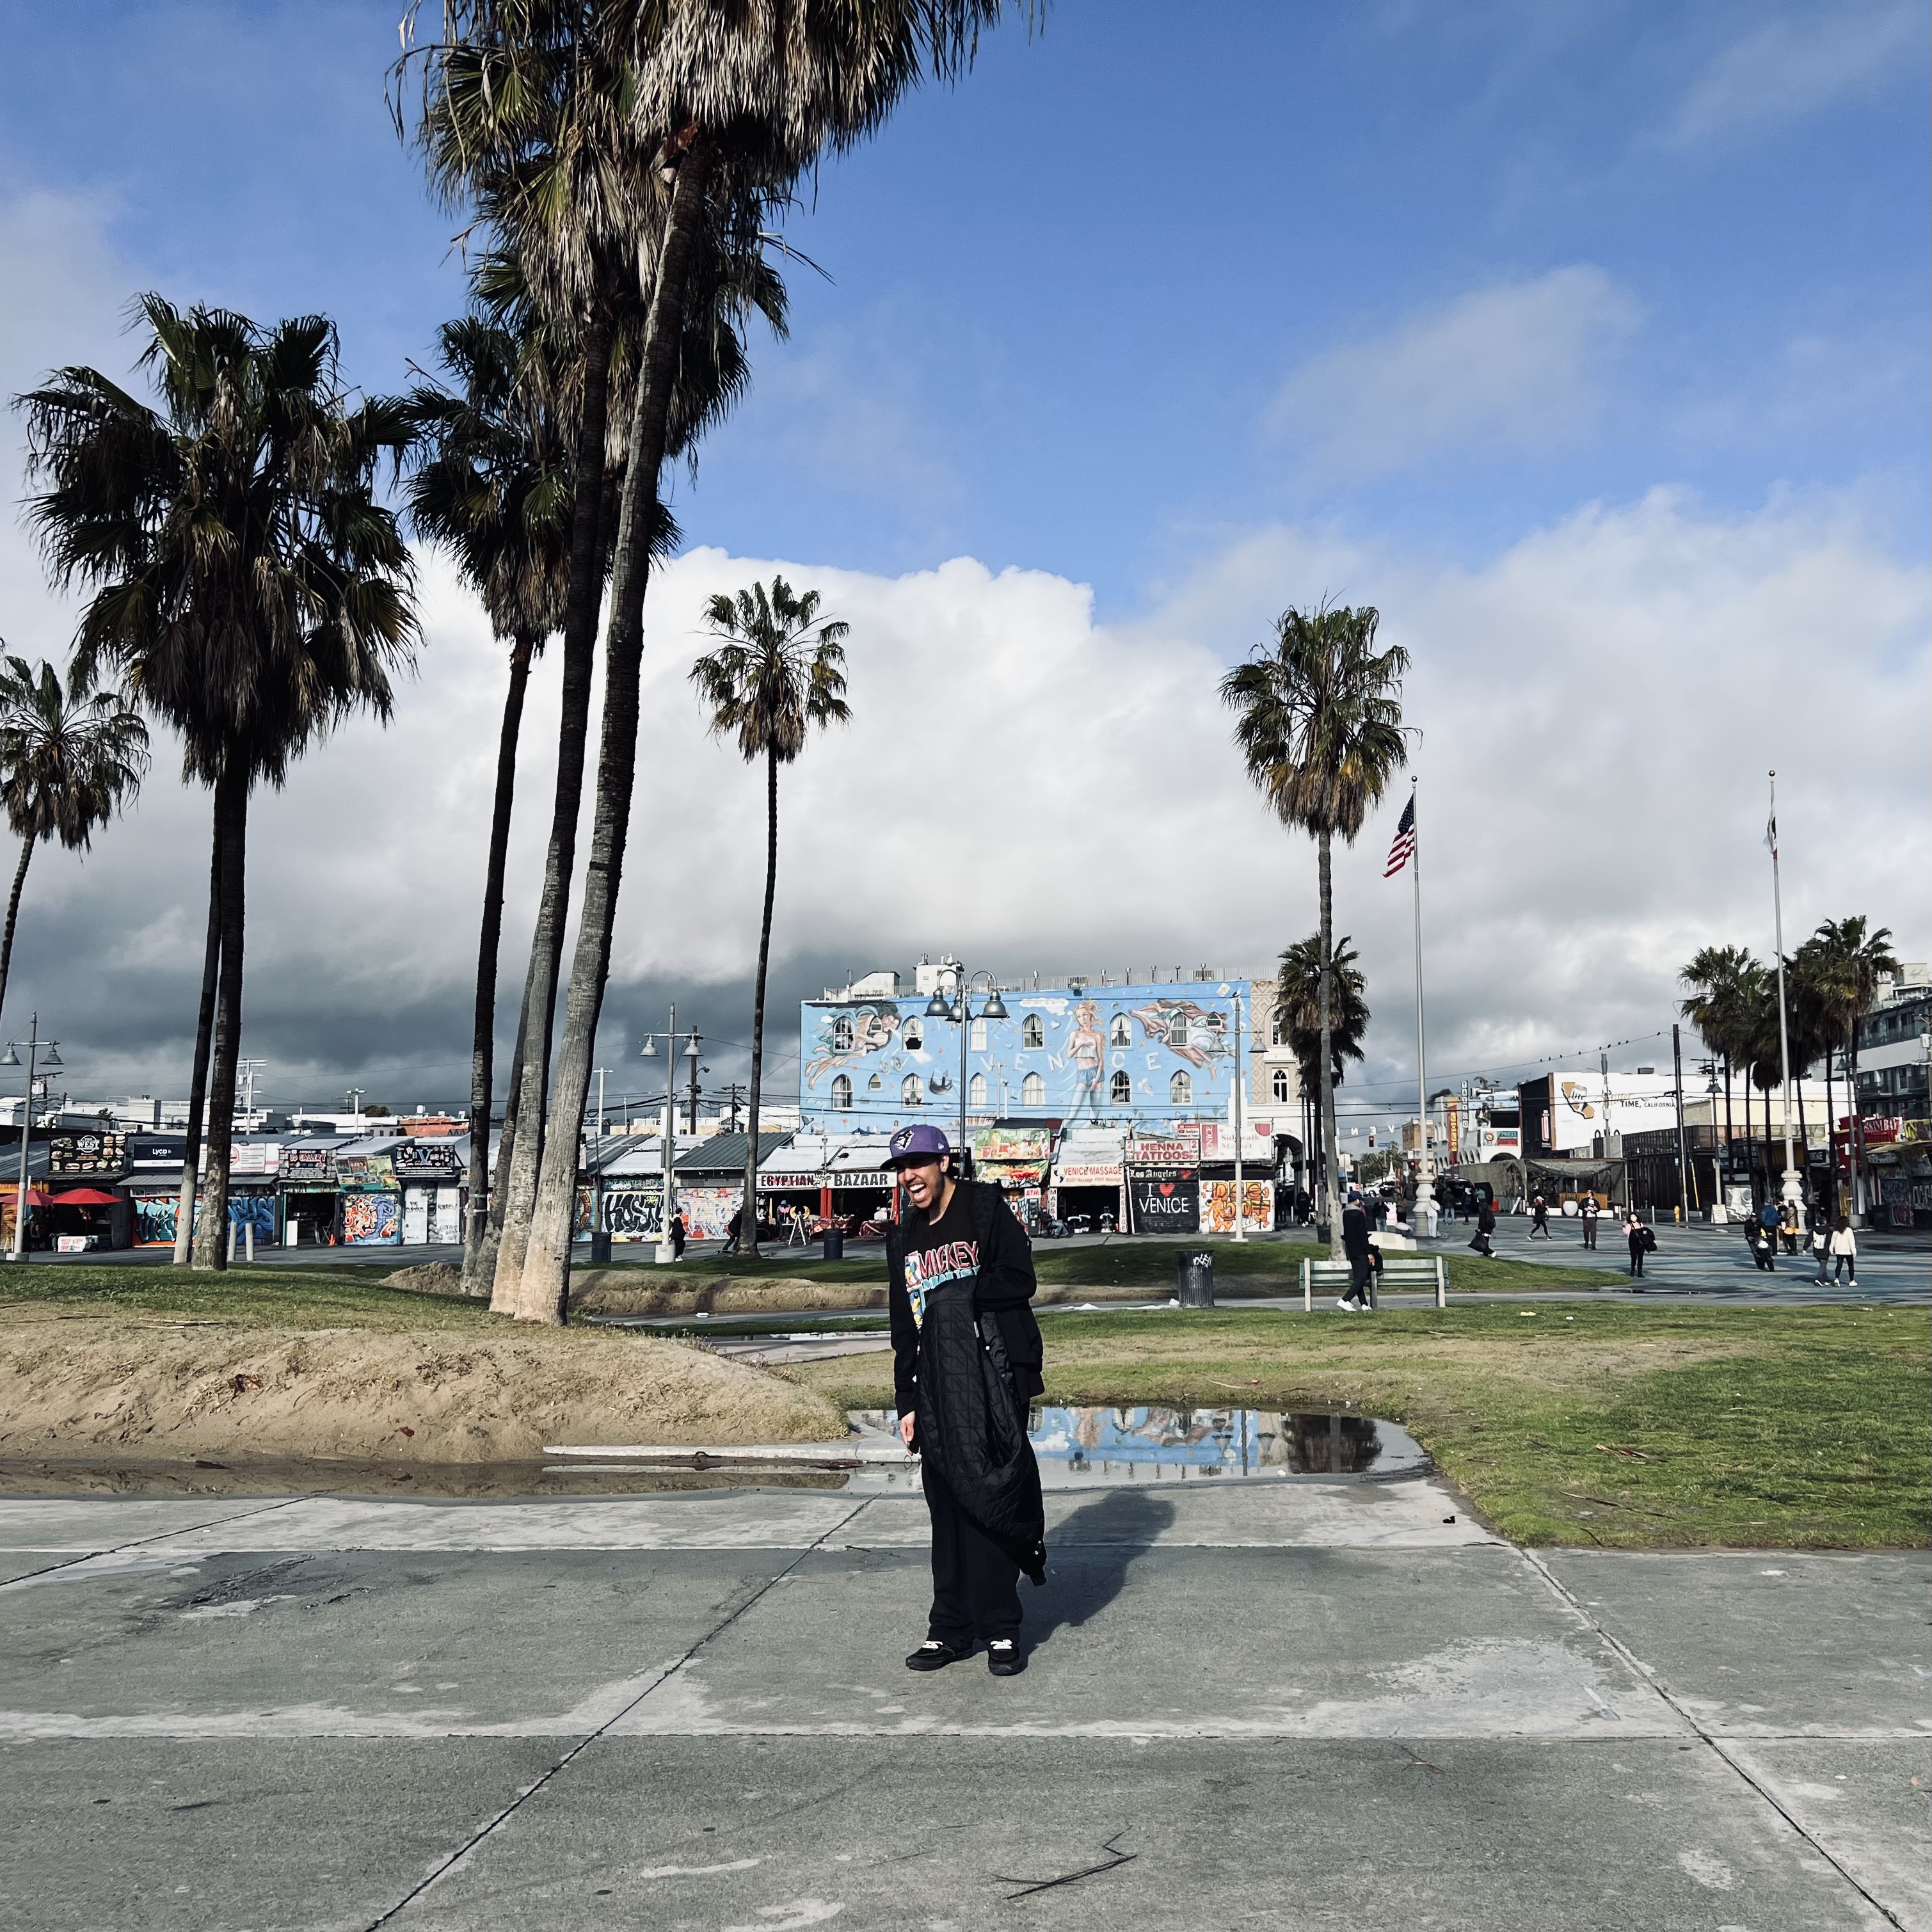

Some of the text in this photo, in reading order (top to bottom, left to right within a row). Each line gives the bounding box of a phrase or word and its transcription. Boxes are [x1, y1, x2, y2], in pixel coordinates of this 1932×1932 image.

[77, 1139, 100, 1148] WEST
[1127, 1141, 1132, 1149] 2
[1192, 1140, 1197, 1149] 2
[1133, 1151, 1190, 1160] TATTOOS
[1064, 1167, 1122, 1176] VENICE MASSAGE
[1130, 1169, 1178, 1178] Los Angeles
[761, 1174, 888, 1187] EGYPTIAN BAZAAR
[1147, 1183, 1153, 1197] I
[1138, 1197, 1190, 1214] VENICE
[919, 1240, 980, 1278] MICKEY
